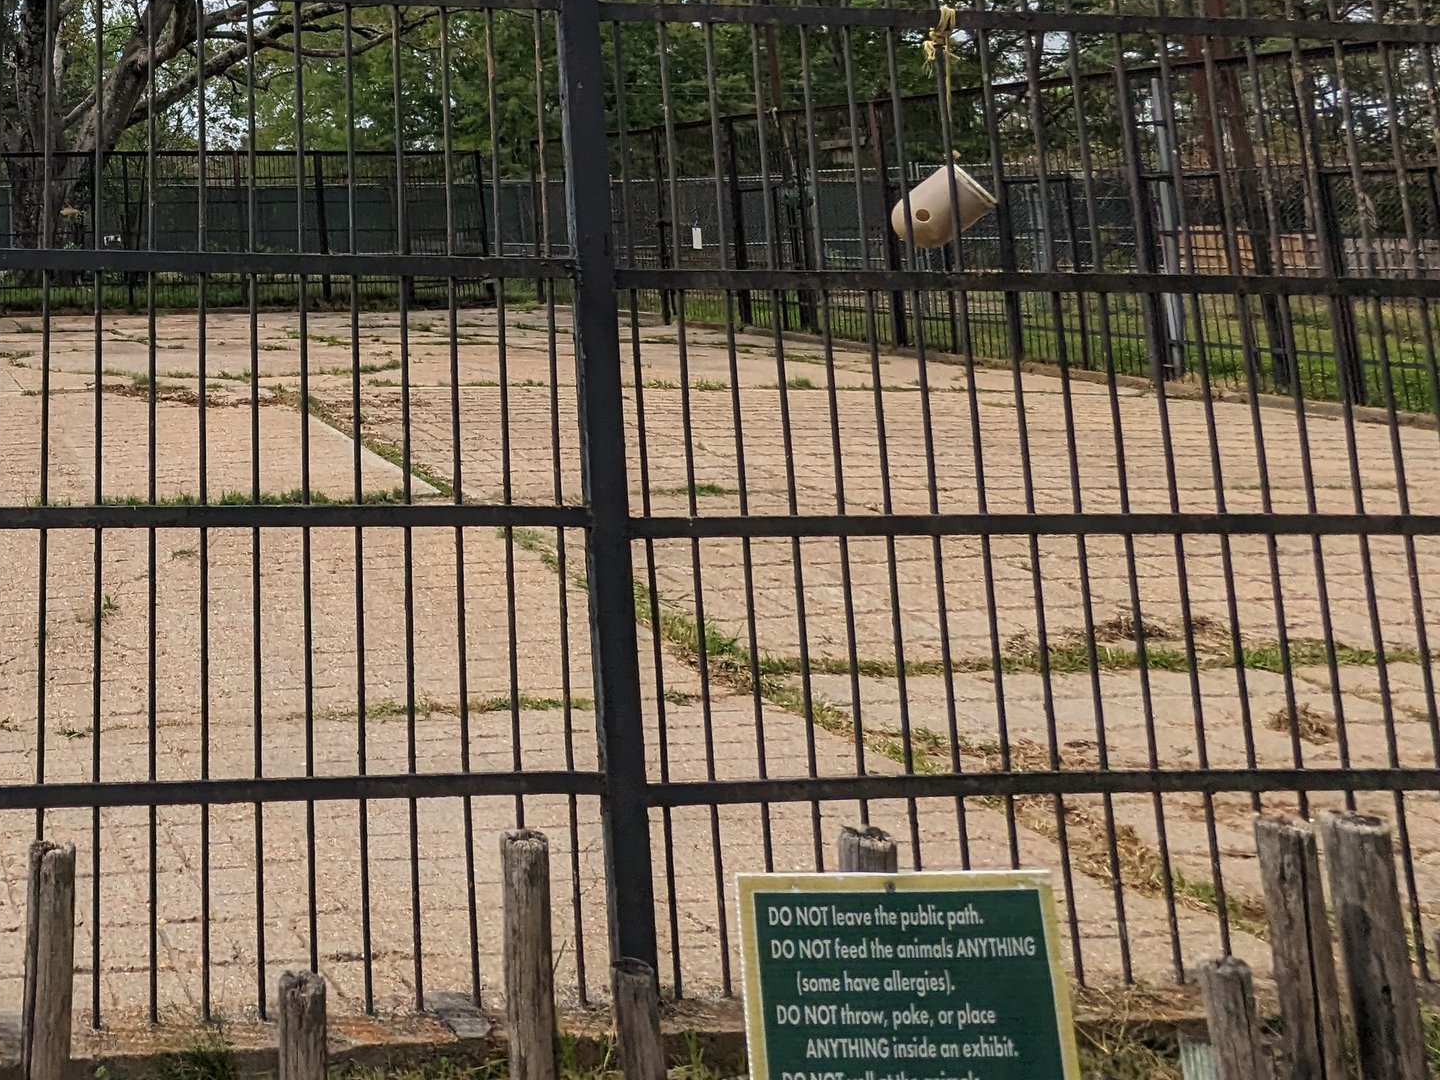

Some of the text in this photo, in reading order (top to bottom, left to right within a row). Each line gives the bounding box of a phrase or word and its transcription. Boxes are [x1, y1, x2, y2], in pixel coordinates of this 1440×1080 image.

[768, 903, 984, 931] DO NOT leave the public path.
[771, 936, 1036, 959] DO NOT feed the animals ANYTHING
[796, 969, 956, 997] (some have allergies).
[776, 1002, 997, 1031] DO NOT throw, poke, or place
[806, 1035, 1020, 1059] ANYTHING inside an exhibit.
